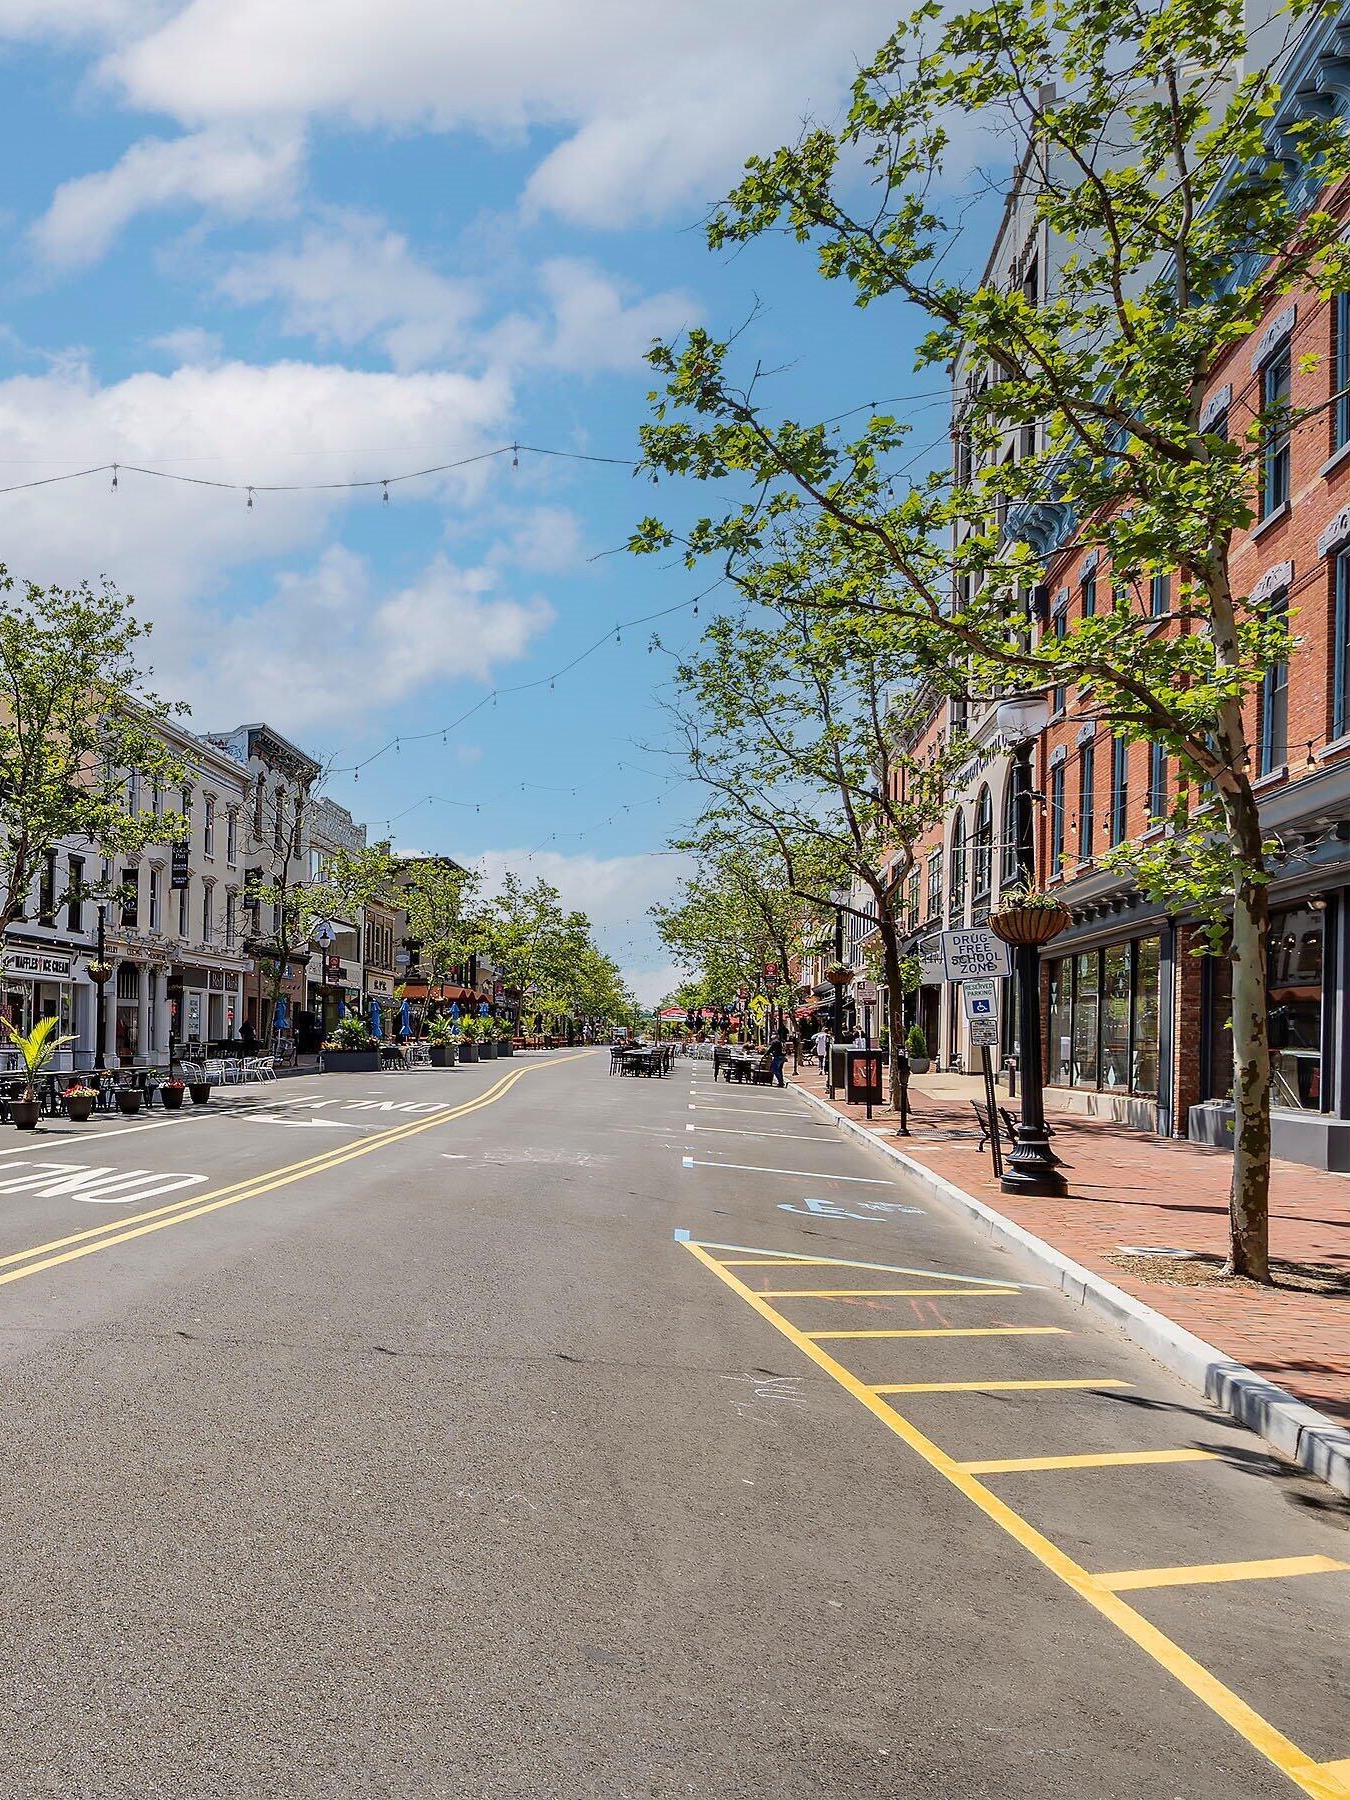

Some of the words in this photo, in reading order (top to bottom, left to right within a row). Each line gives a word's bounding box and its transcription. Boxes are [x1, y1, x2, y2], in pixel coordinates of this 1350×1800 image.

[959, 943, 991, 954] FREE
[15, 956, 38, 970] WAFFLES
[43, 959, 52, 972] ICE
[51, 960, 69, 973] CREAM
[951, 952, 1002, 965] SCHOOL
[960, 962, 996, 973] ZONE
